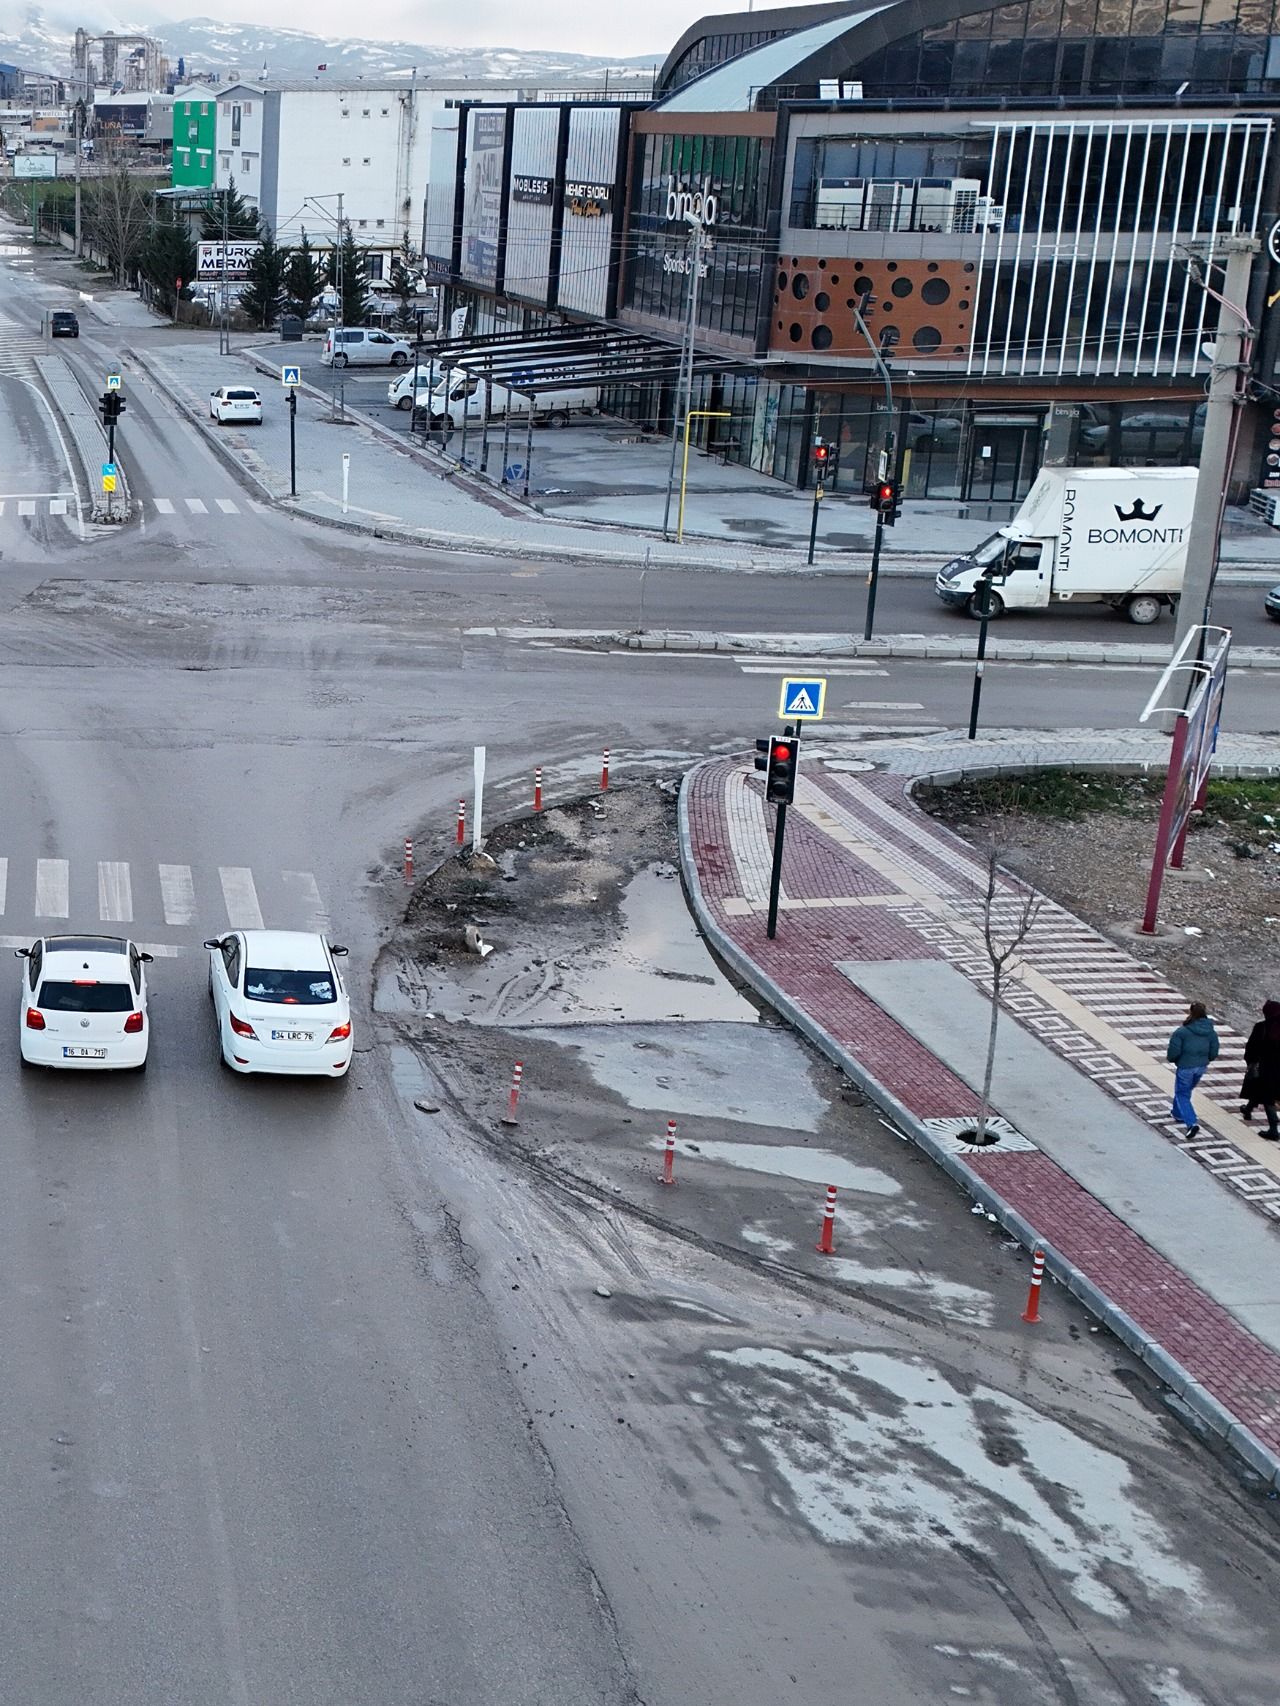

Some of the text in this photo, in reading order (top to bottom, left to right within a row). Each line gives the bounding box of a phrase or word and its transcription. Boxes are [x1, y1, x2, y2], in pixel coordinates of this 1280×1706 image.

[216, 248, 262, 257] FURKA
[201, 259, 252, 269] MERM
[664, 253, 709, 279] Sports Cter
[1088, 528, 1183, 544] BOMONTI
